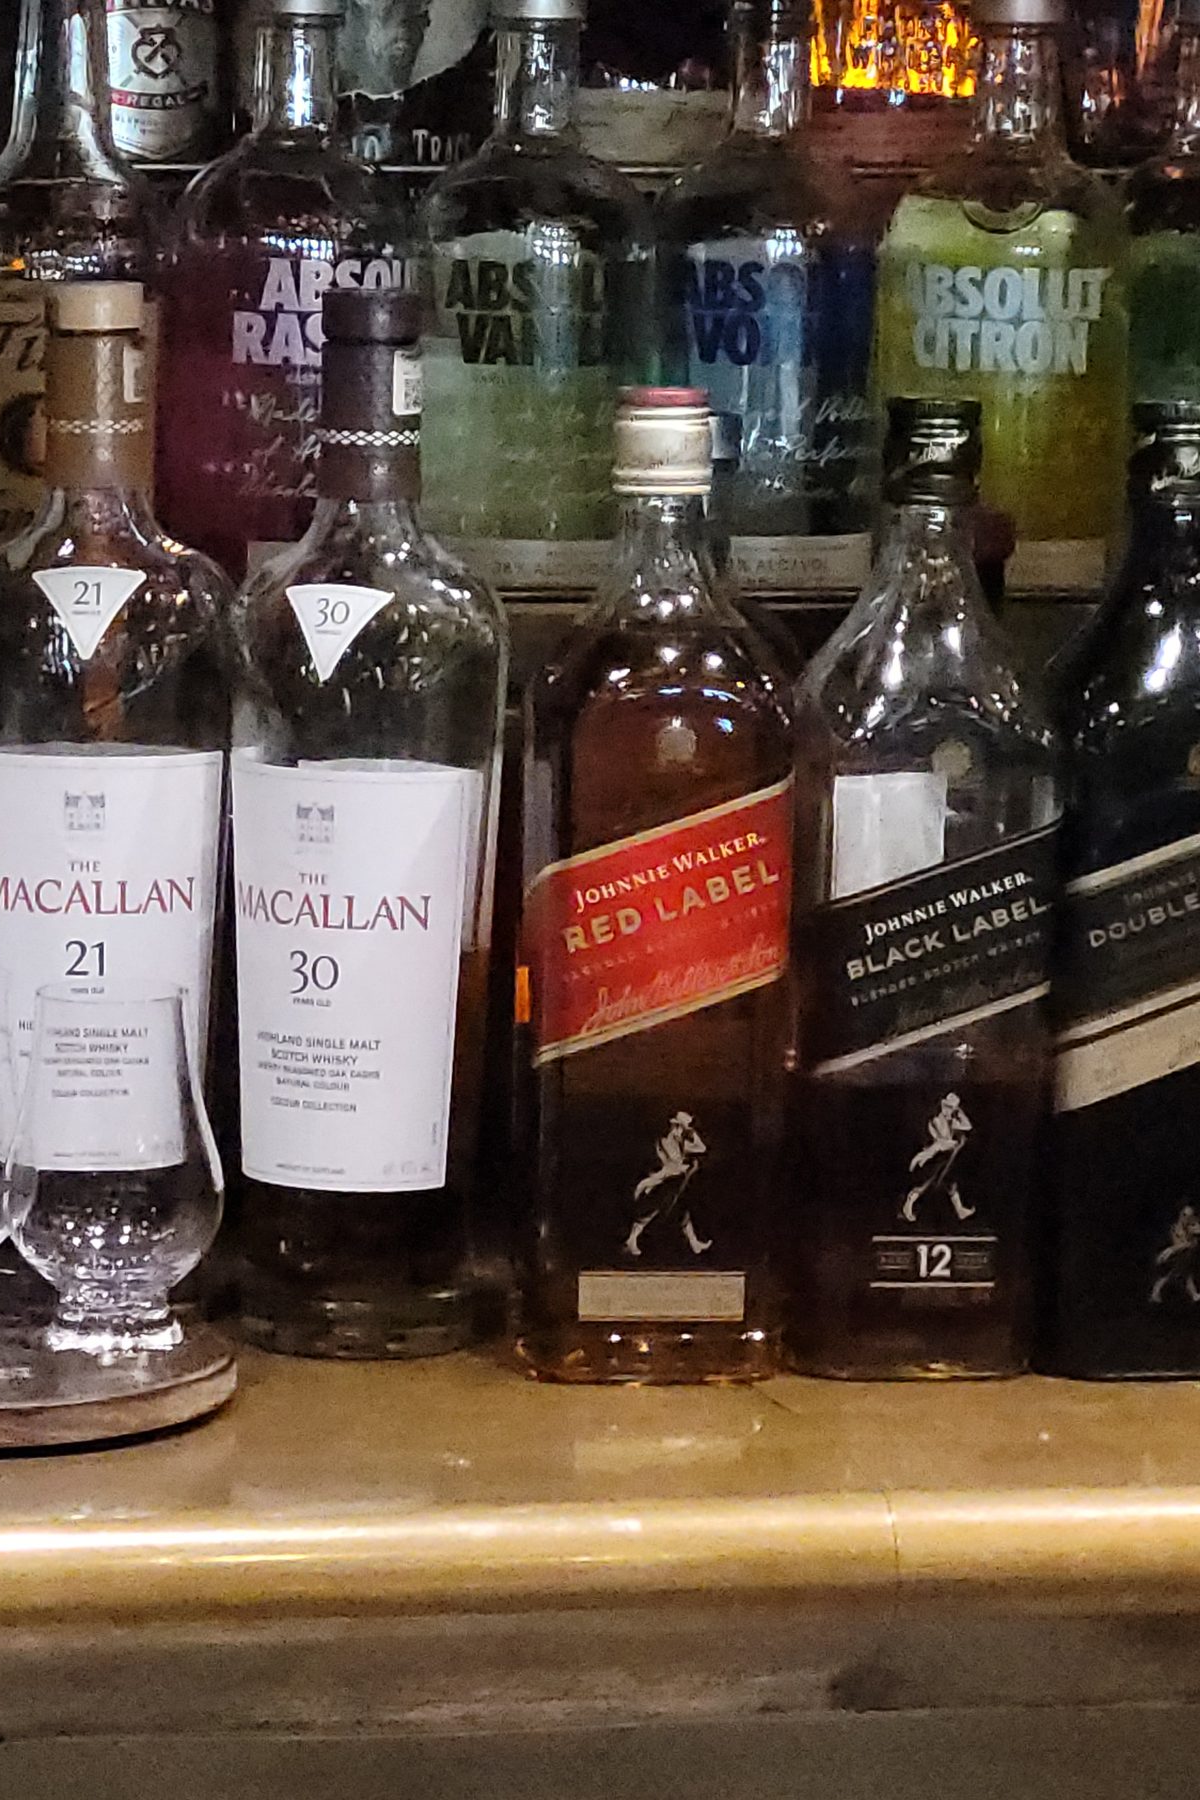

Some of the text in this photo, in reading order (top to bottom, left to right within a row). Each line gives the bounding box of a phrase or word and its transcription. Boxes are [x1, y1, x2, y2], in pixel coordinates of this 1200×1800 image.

[914, 318, 1089, 375] CITRON
[73, 580, 102, 606] 21
[314, 597, 350, 628] 30
[68, 860, 102, 872] THE
[298, 872, 329, 885] THE
[576, 832, 760, 914] JOHNNIE WALKER
[238, 880, 431, 931] MACALLAN
[561, 907, 642, 954] RED
[654, 858, 780, 923] LABEL
[864, 872, 1027, 946] JOHNNIE WALKER
[1088, 891, 1200, 948] DOUBLE
[65, 940, 106, 978] 21
[846, 896, 1051, 981] BLACK LABEL
[289, 950, 339, 994] 30
[305, 1037, 345, 1050] SINGLE
[349, 1040, 381, 1050] MALT
[312, 1054, 358, 1066] WHISKY
[916, 1243, 952, 1278] 12
